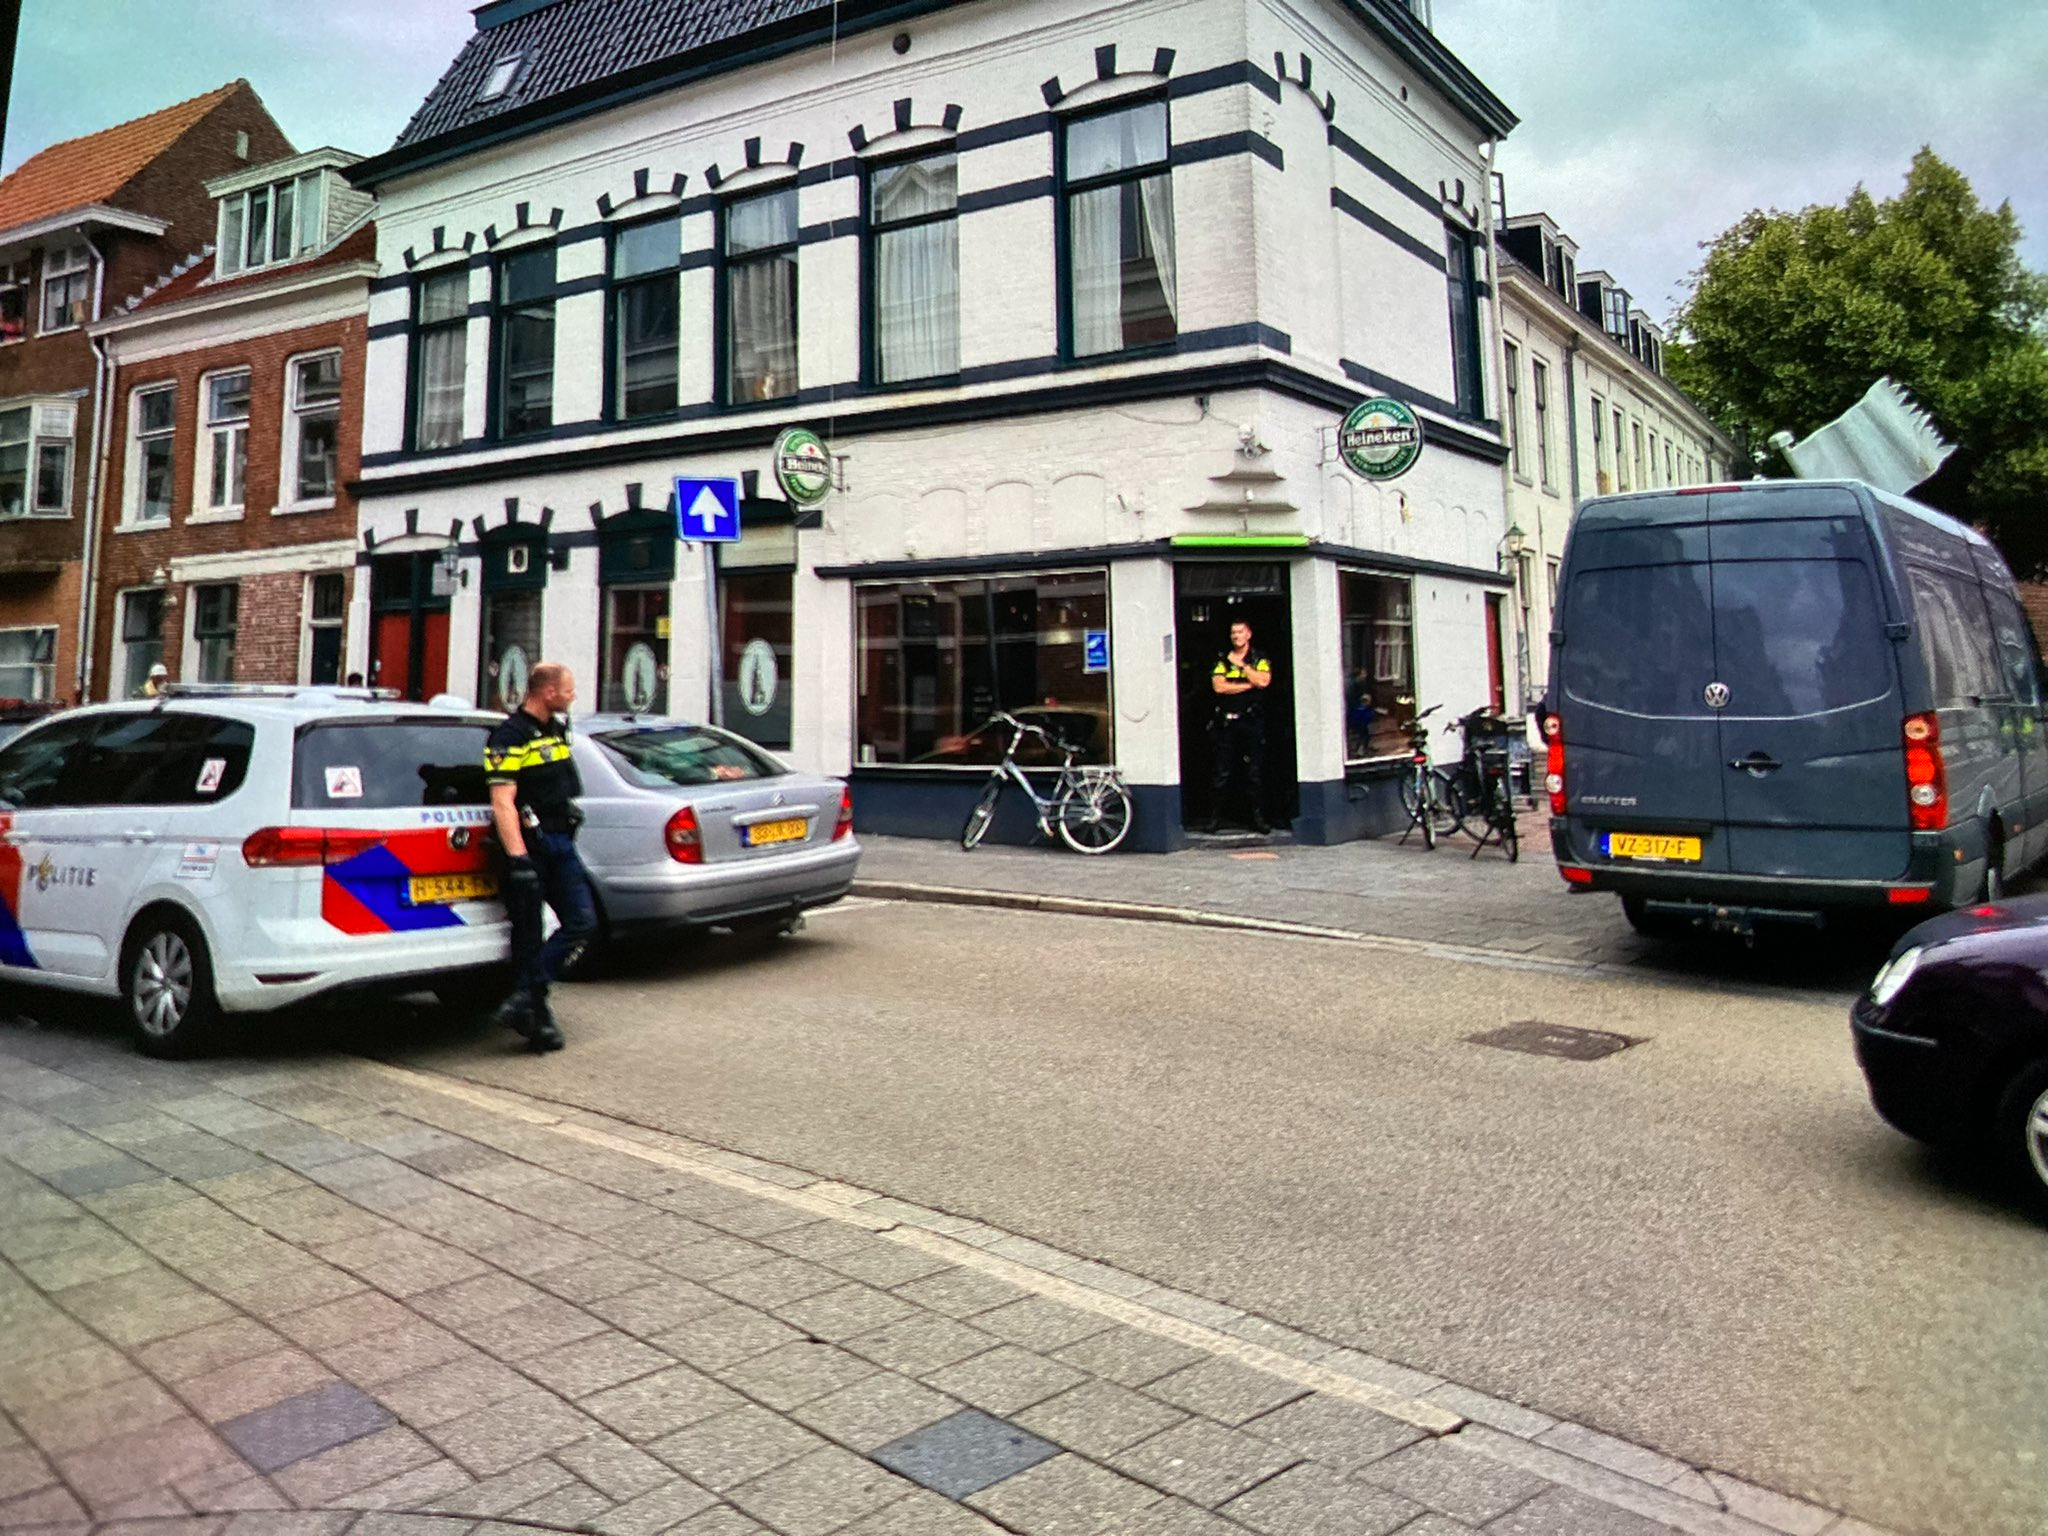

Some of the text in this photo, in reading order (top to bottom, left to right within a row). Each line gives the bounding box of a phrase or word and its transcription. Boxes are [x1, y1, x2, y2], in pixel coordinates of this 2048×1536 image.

[1347, 430, 1411, 447] Heineken
[787, 458, 829, 475] Heineke
[1581, 796, 1637, 806] CRAFTER
[420, 810, 493, 823] POLITIE
